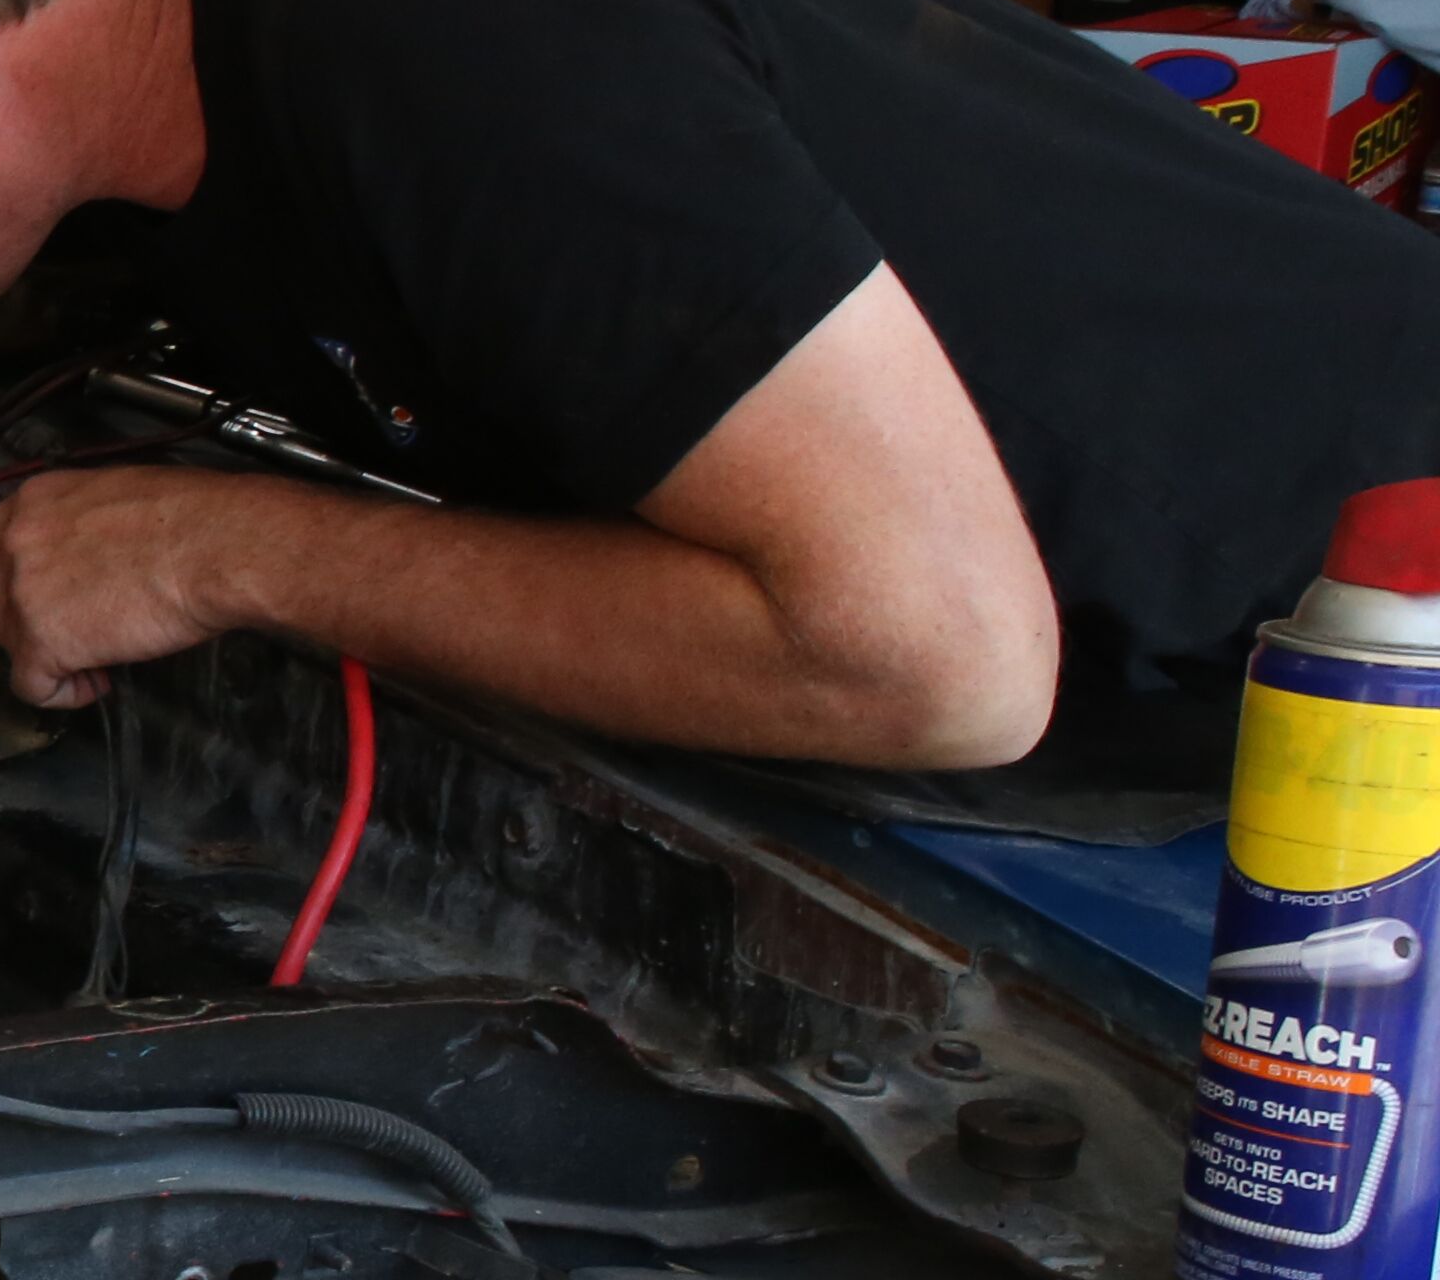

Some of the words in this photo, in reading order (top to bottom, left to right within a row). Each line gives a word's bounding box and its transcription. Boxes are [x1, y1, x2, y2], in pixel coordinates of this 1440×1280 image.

[1347, 88, 1422, 184] SHOP
[1280, 886, 1373, 907] PRODUCT
[1202, 995, 1377, 1071] Z-REACH
[1268, 1063, 1352, 1088] STRAW
[1262, 1100, 1347, 1132] SHAPE
[1213, 1131, 1244, 1151] GETS
[1246, 1142, 1282, 1161] INTO
[1204, 1167, 1284, 1206] SPACES
